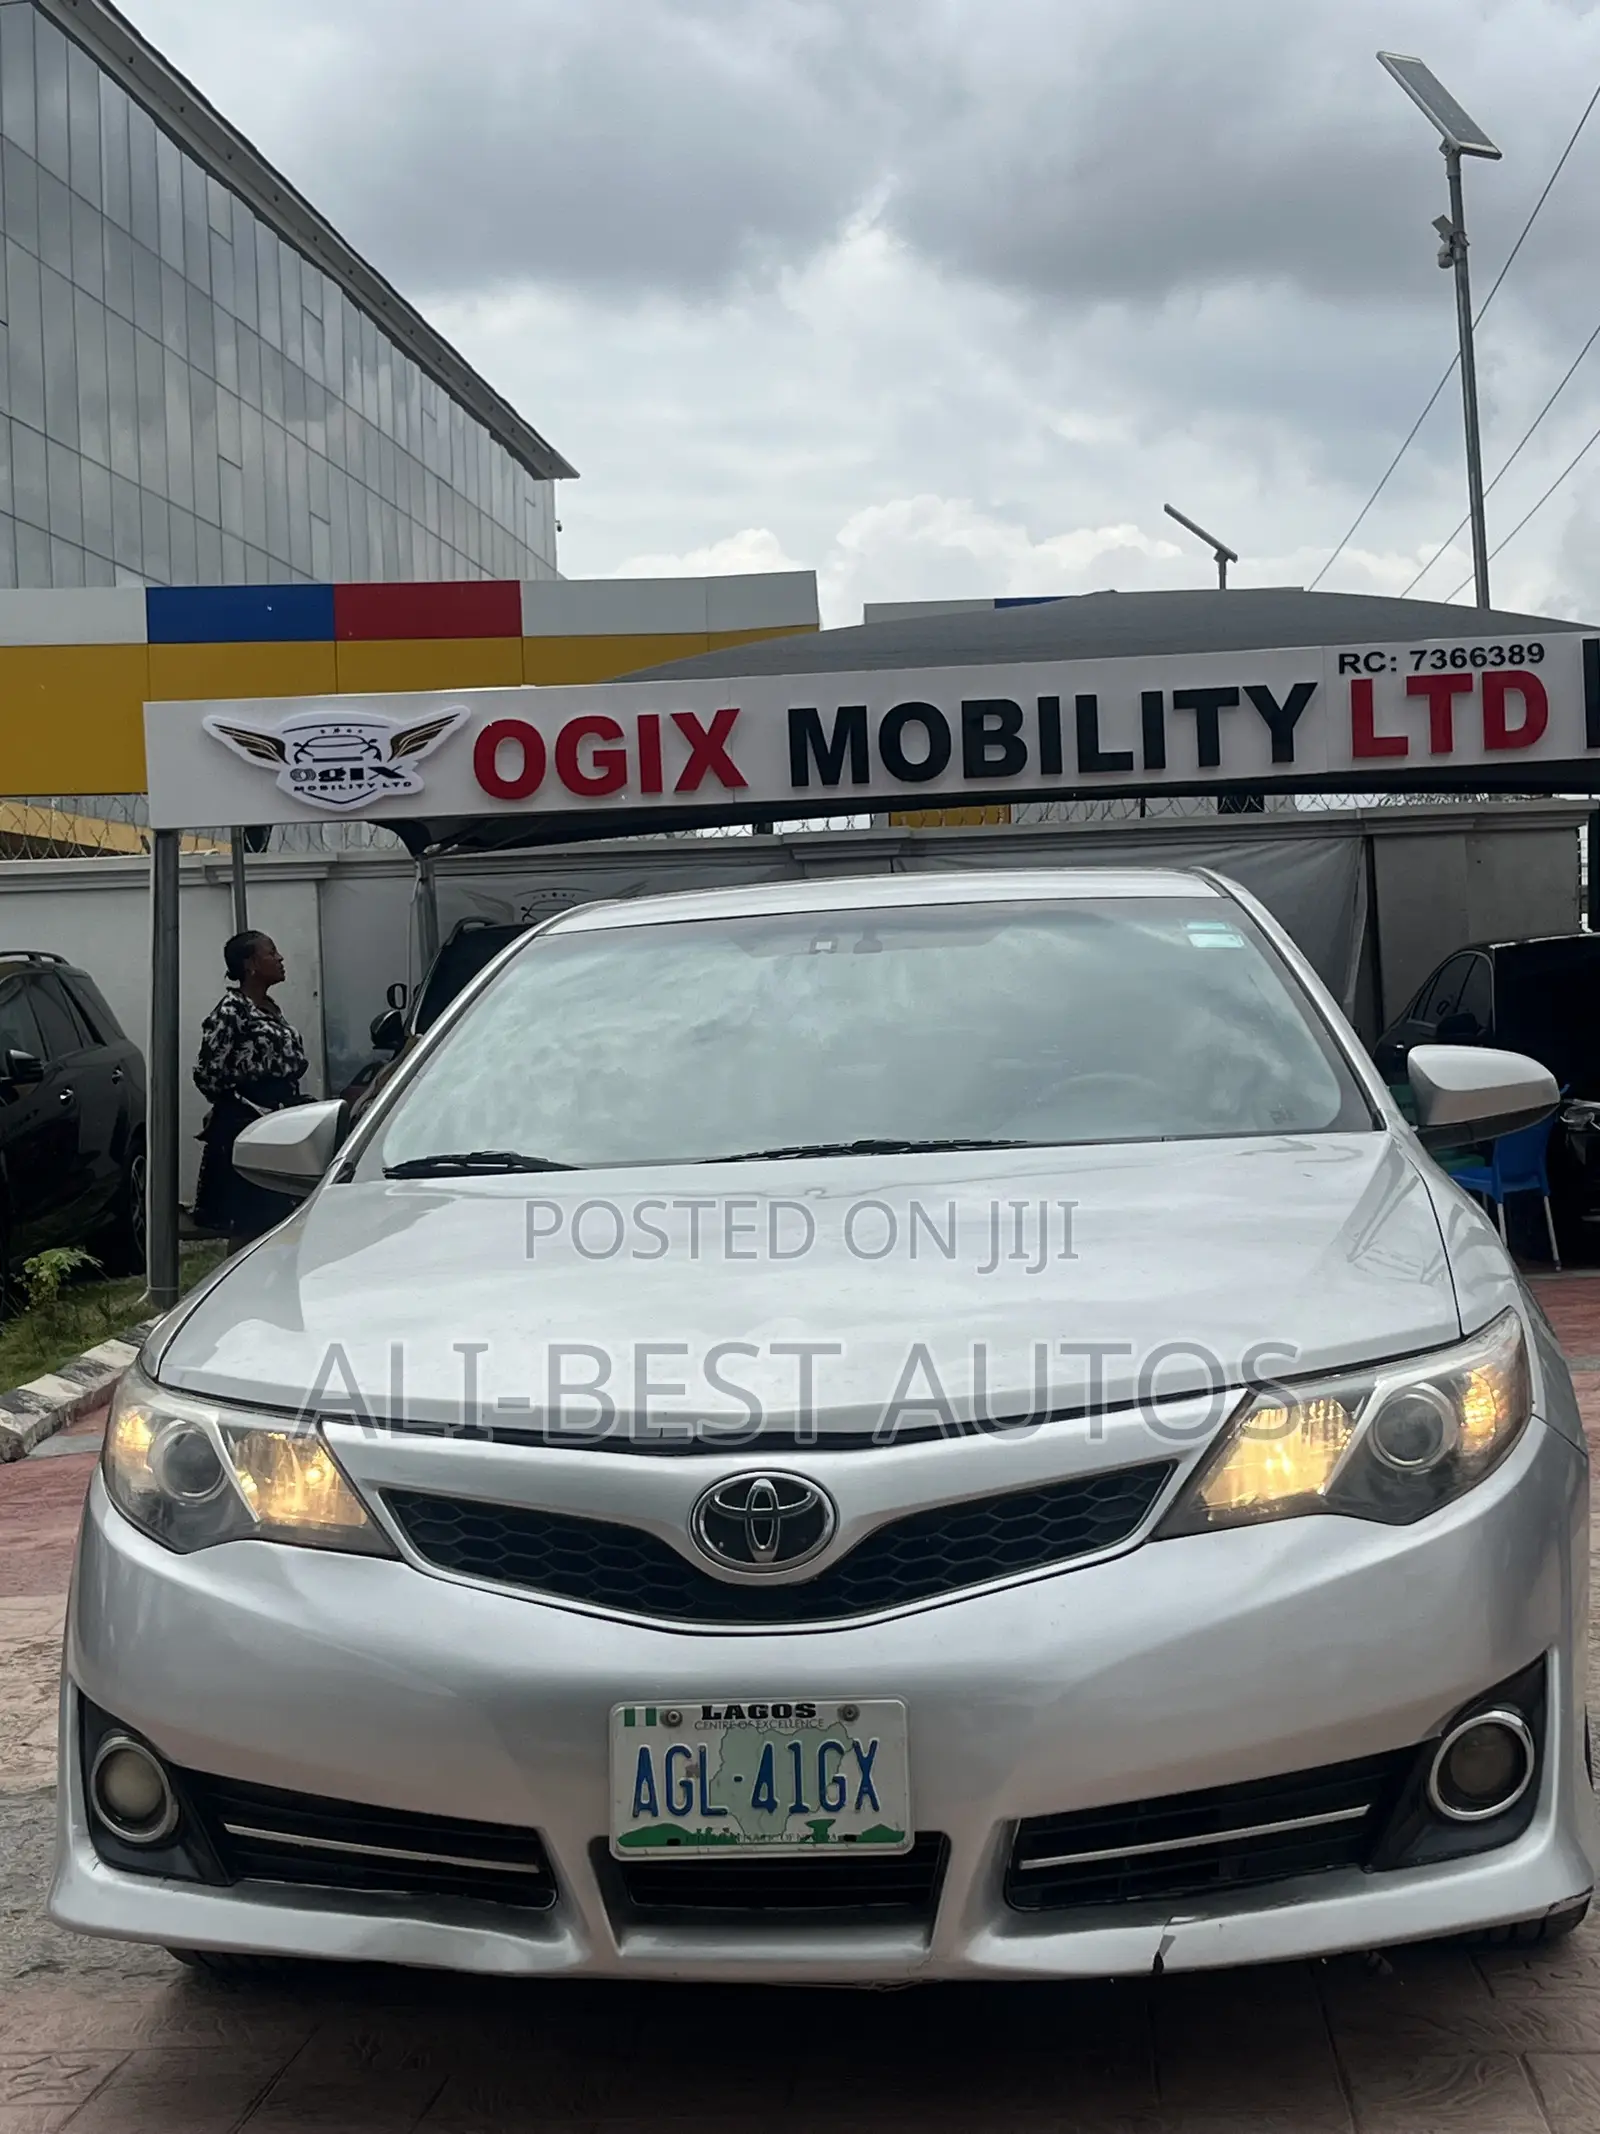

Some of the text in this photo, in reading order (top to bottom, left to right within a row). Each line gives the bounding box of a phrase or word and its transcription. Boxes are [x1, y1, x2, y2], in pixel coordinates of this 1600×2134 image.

[1338, 642, 1545, 674] RC: 7366389
[473, 708, 749, 800] OGIX
[788, 682, 1318, 787] MOBILITY
[1350, 669, 1548, 758] LTD
[701, 1703, 816, 1720] LAGOS
[694, 1720, 739, 1731] CENTRE
[756, 1718, 825, 1729] EXCELLENCE
